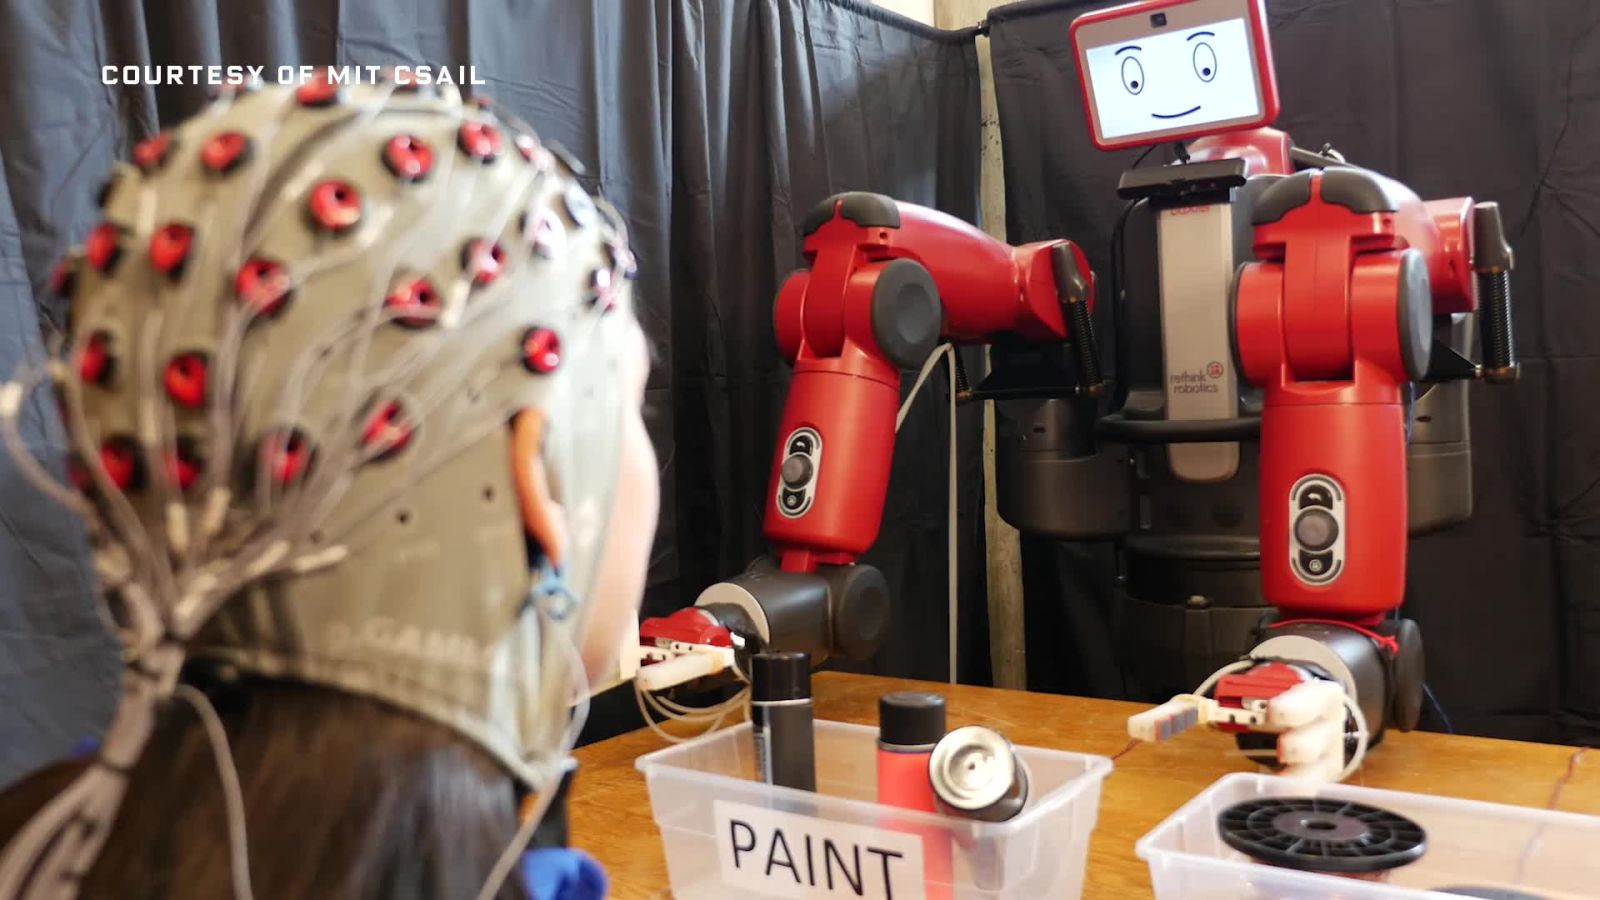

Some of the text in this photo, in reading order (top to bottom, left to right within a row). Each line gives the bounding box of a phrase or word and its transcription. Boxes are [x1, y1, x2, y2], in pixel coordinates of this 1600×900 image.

[1170, 370, 1207, 383] rethink
[1173, 384, 1218, 393] robotics
[730, 820, 903, 900] PAINT
